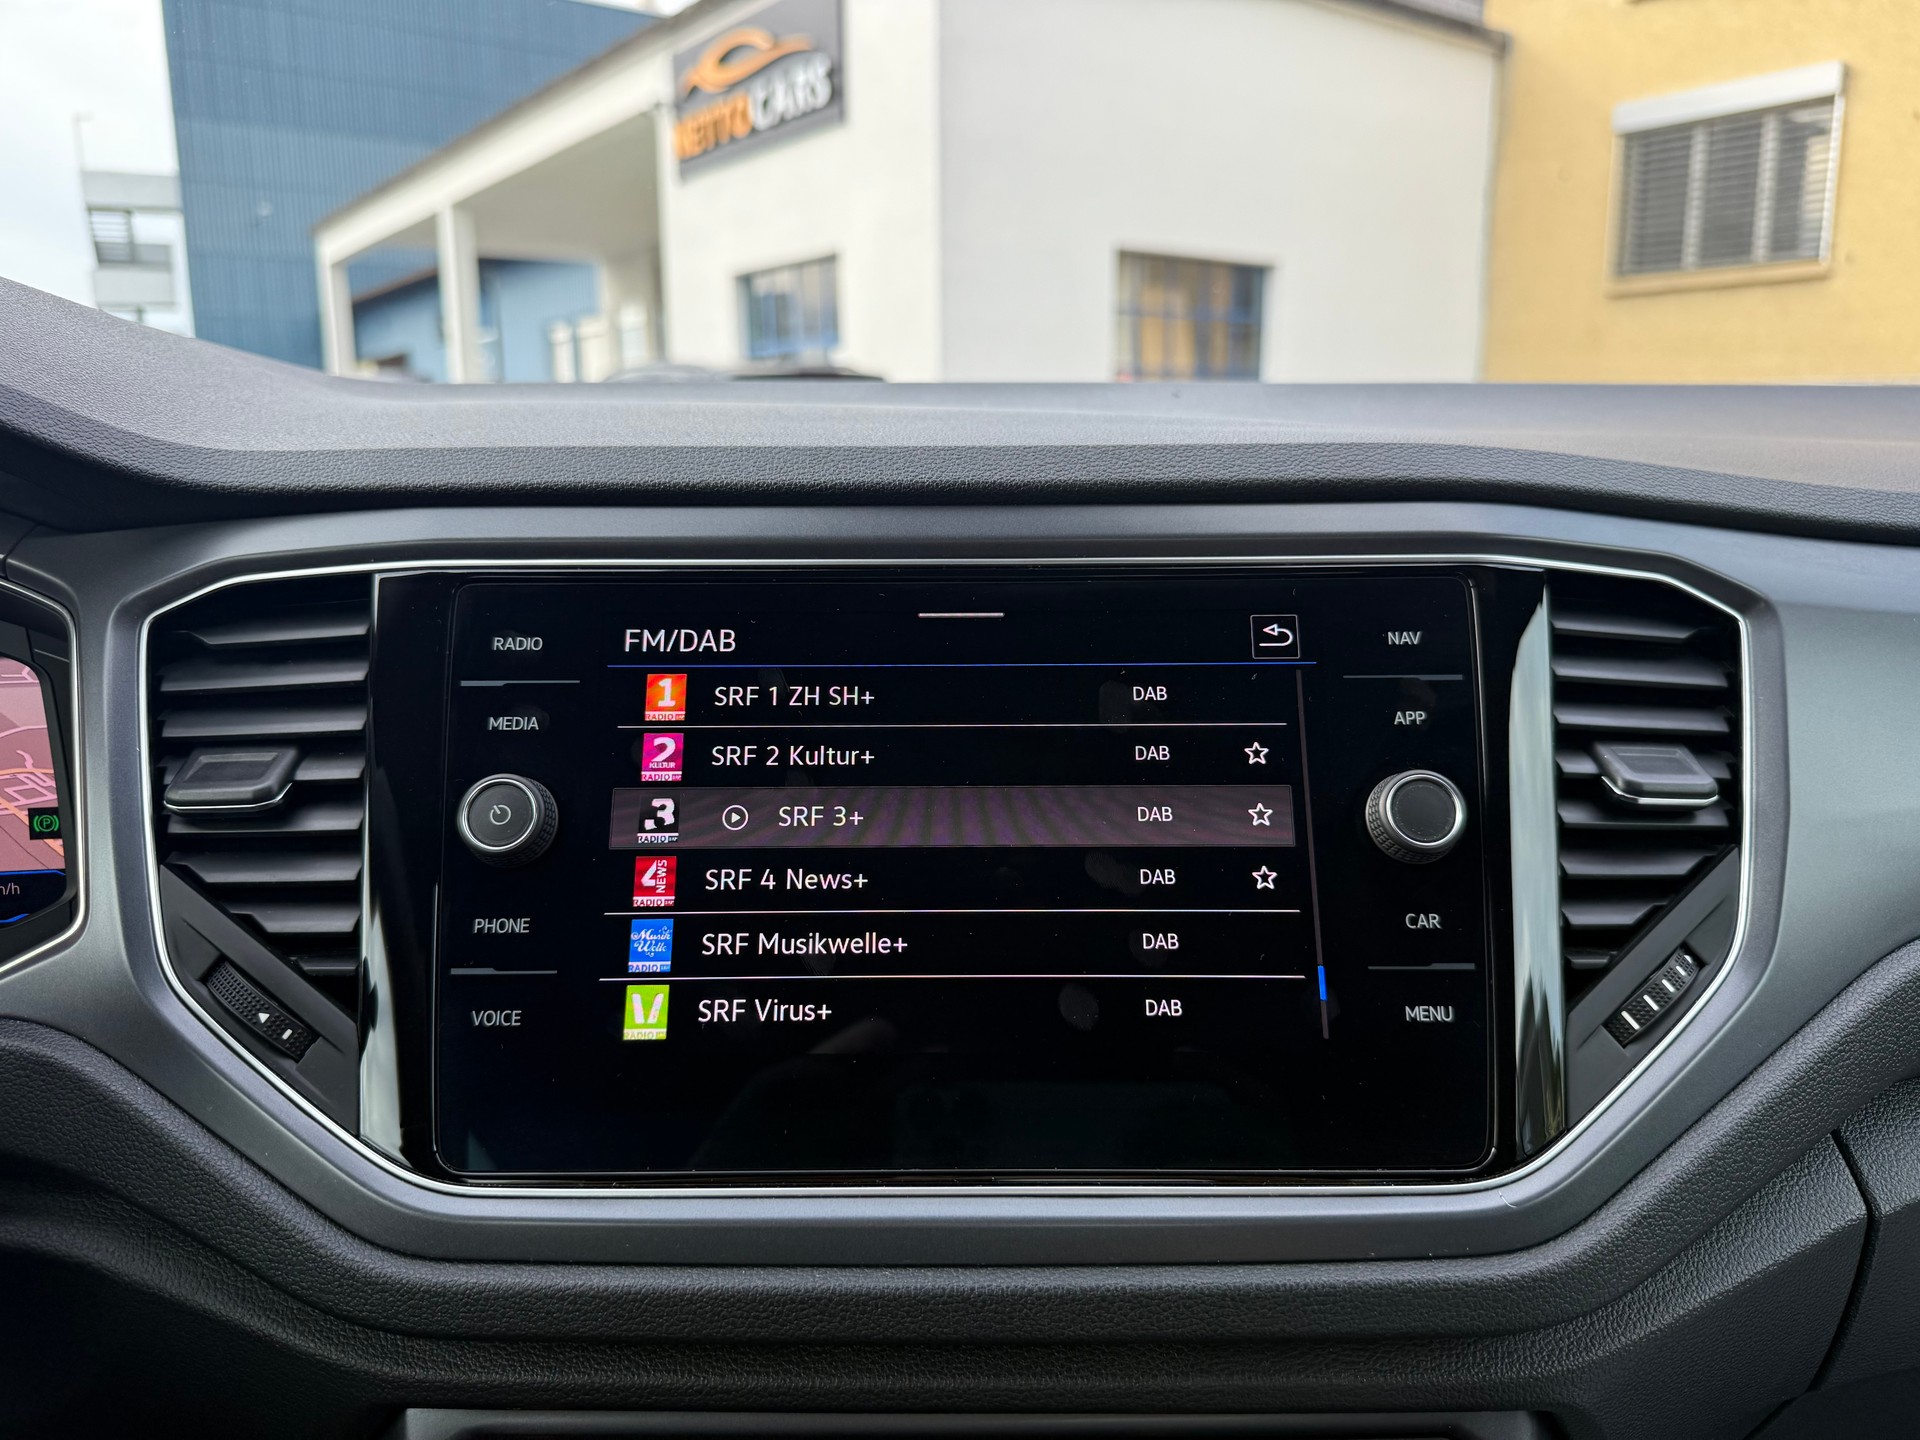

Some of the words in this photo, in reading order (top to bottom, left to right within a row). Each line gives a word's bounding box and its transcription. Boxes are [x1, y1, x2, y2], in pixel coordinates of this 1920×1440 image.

[493, 636, 543, 651] RADIO
[624, 629, 736, 652] FM/DAB
[1387, 631, 1421, 645] NAV
[658, 678, 676, 707] 1
[714, 686, 760, 706] SRF
[769, 686, 778, 706] 1
[789, 686, 820, 706] ZH
[829, 685, 875, 706] SH+
[1132, 686, 1168, 701] DAB
[488, 716, 540, 731] MEDIA
[1393, 710, 1426, 725] APP
[651, 737, 676, 762] 2
[711, 745, 758, 766] SRF
[765, 745, 779, 766] 2
[789, 745, 875, 766] Kultur+
[1135, 745, 1170, 761] DAB
[778, 805, 825, 827] SRF
[833, 805, 864, 827] 3+
[1137, 806, 1173, 822] DAB
[655, 859, 668, 894] NEWS
[705, 868, 753, 891] SRF
[760, 868, 776, 890] 4
[786, 868, 869, 890] News+
[1139, 868, 1176, 885] DAB
[474, 917, 531, 934] PHONE
[1405, 913, 1442, 929] CAR
[701, 932, 750, 956] SRF
[758, 931, 908, 955] Musikwelle+
[1142, 933, 1180, 950] DAB
[697, 999, 747, 1023] SRF
[754, 998, 832, 1022] Virus+
[1145, 999, 1183, 1017] DAB
[1405, 1005, 1453, 1022] MENU
[472, 1010, 522, 1027] VOICE
